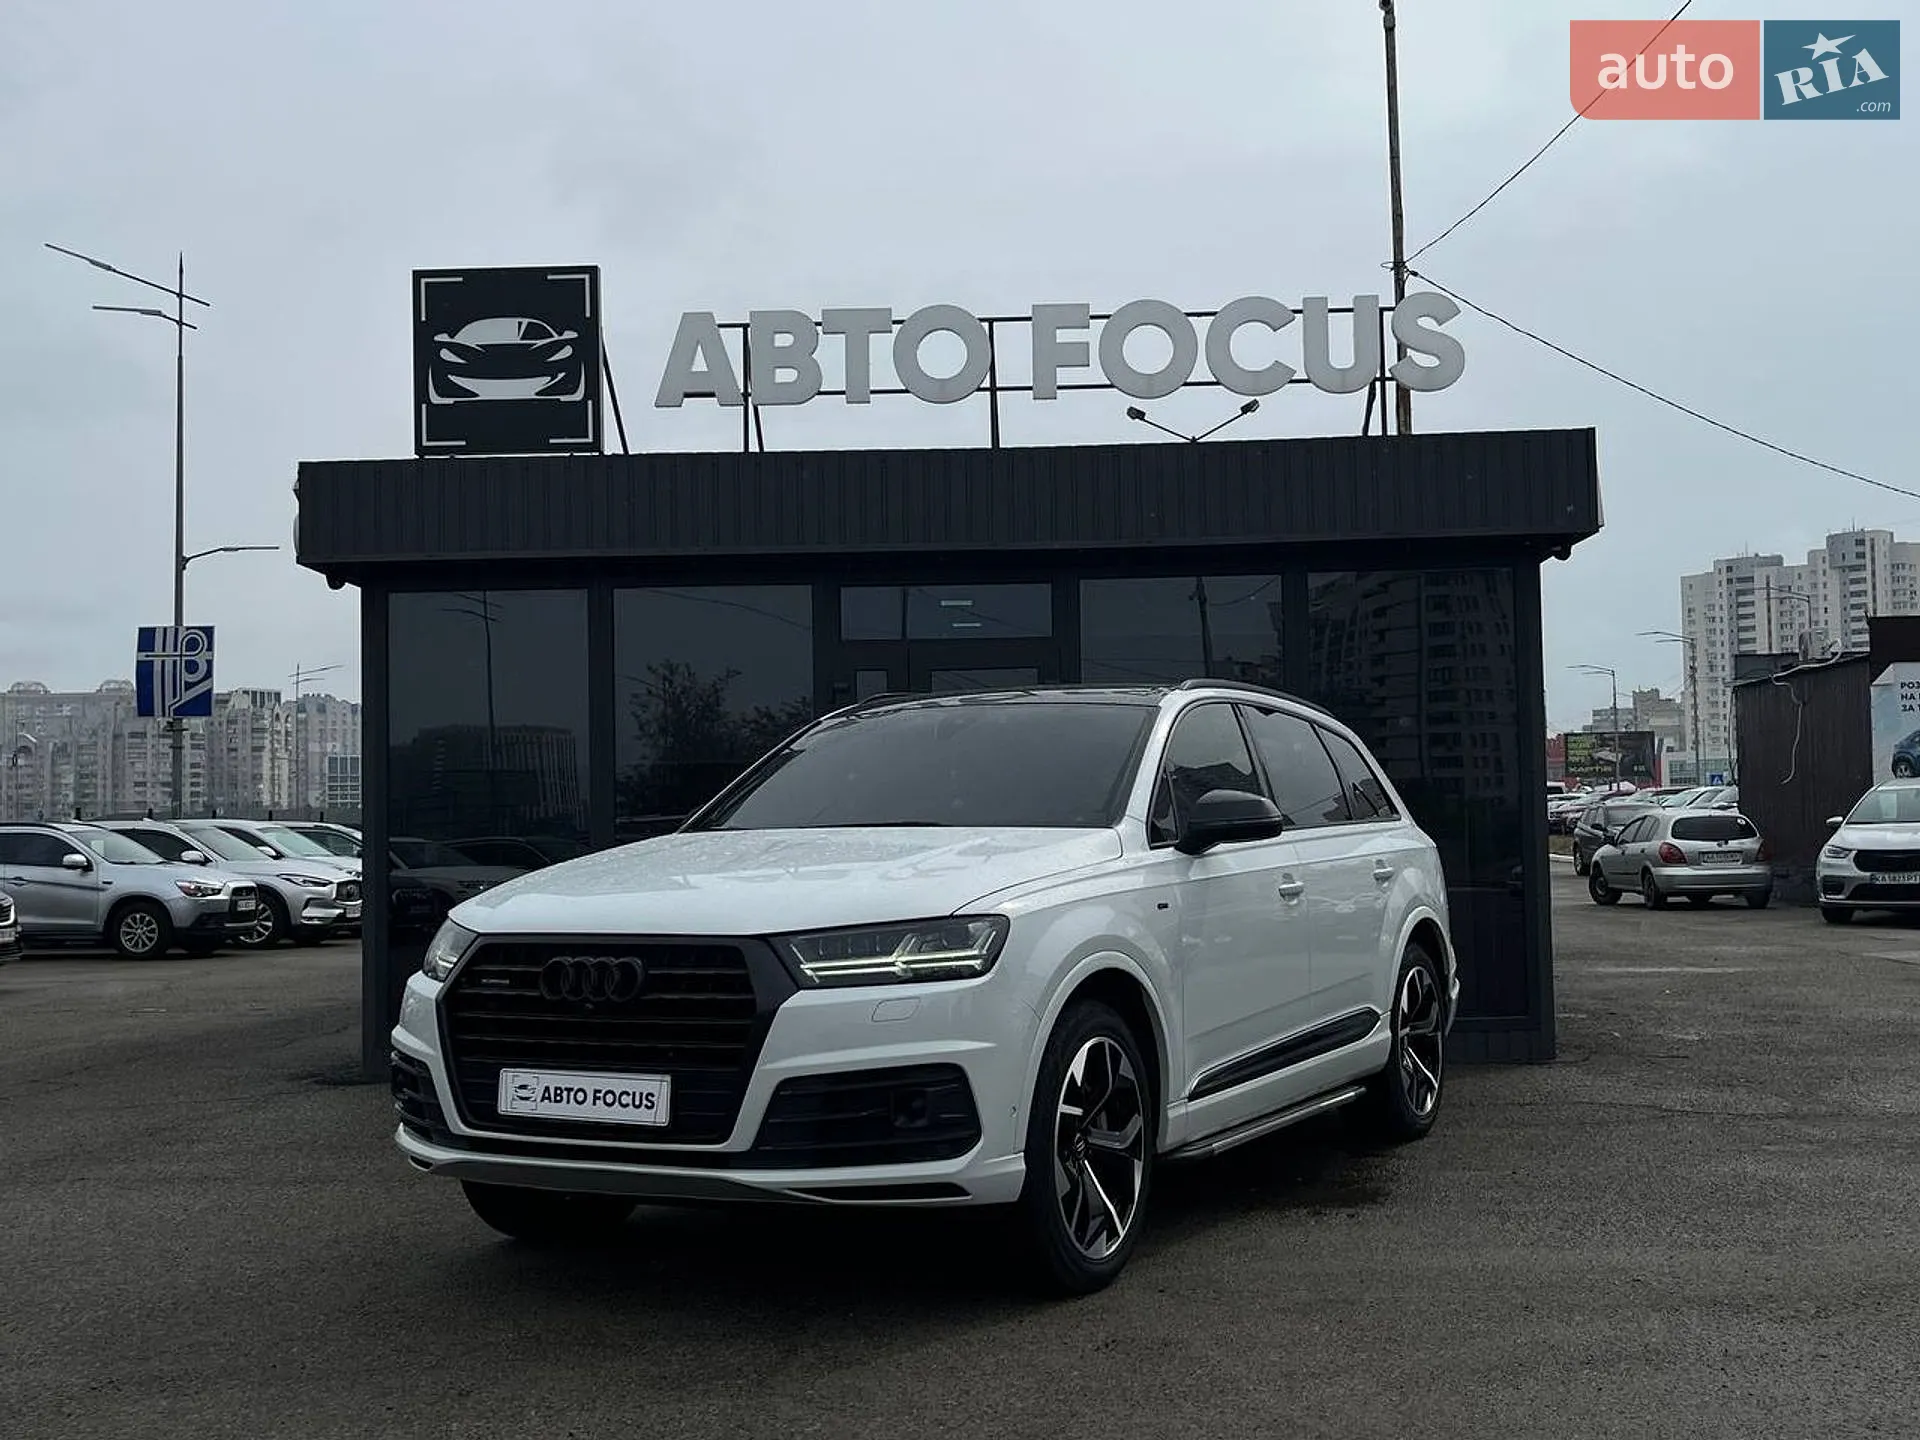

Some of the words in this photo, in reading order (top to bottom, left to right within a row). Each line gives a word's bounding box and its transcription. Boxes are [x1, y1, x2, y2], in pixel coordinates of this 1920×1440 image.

[655, 304, 992, 408] АВТО
[1032, 291, 1465, 400] FOCUS
[540, 1086, 588, 1106] АВТО
[592, 1089, 656, 1110] FOCUS
